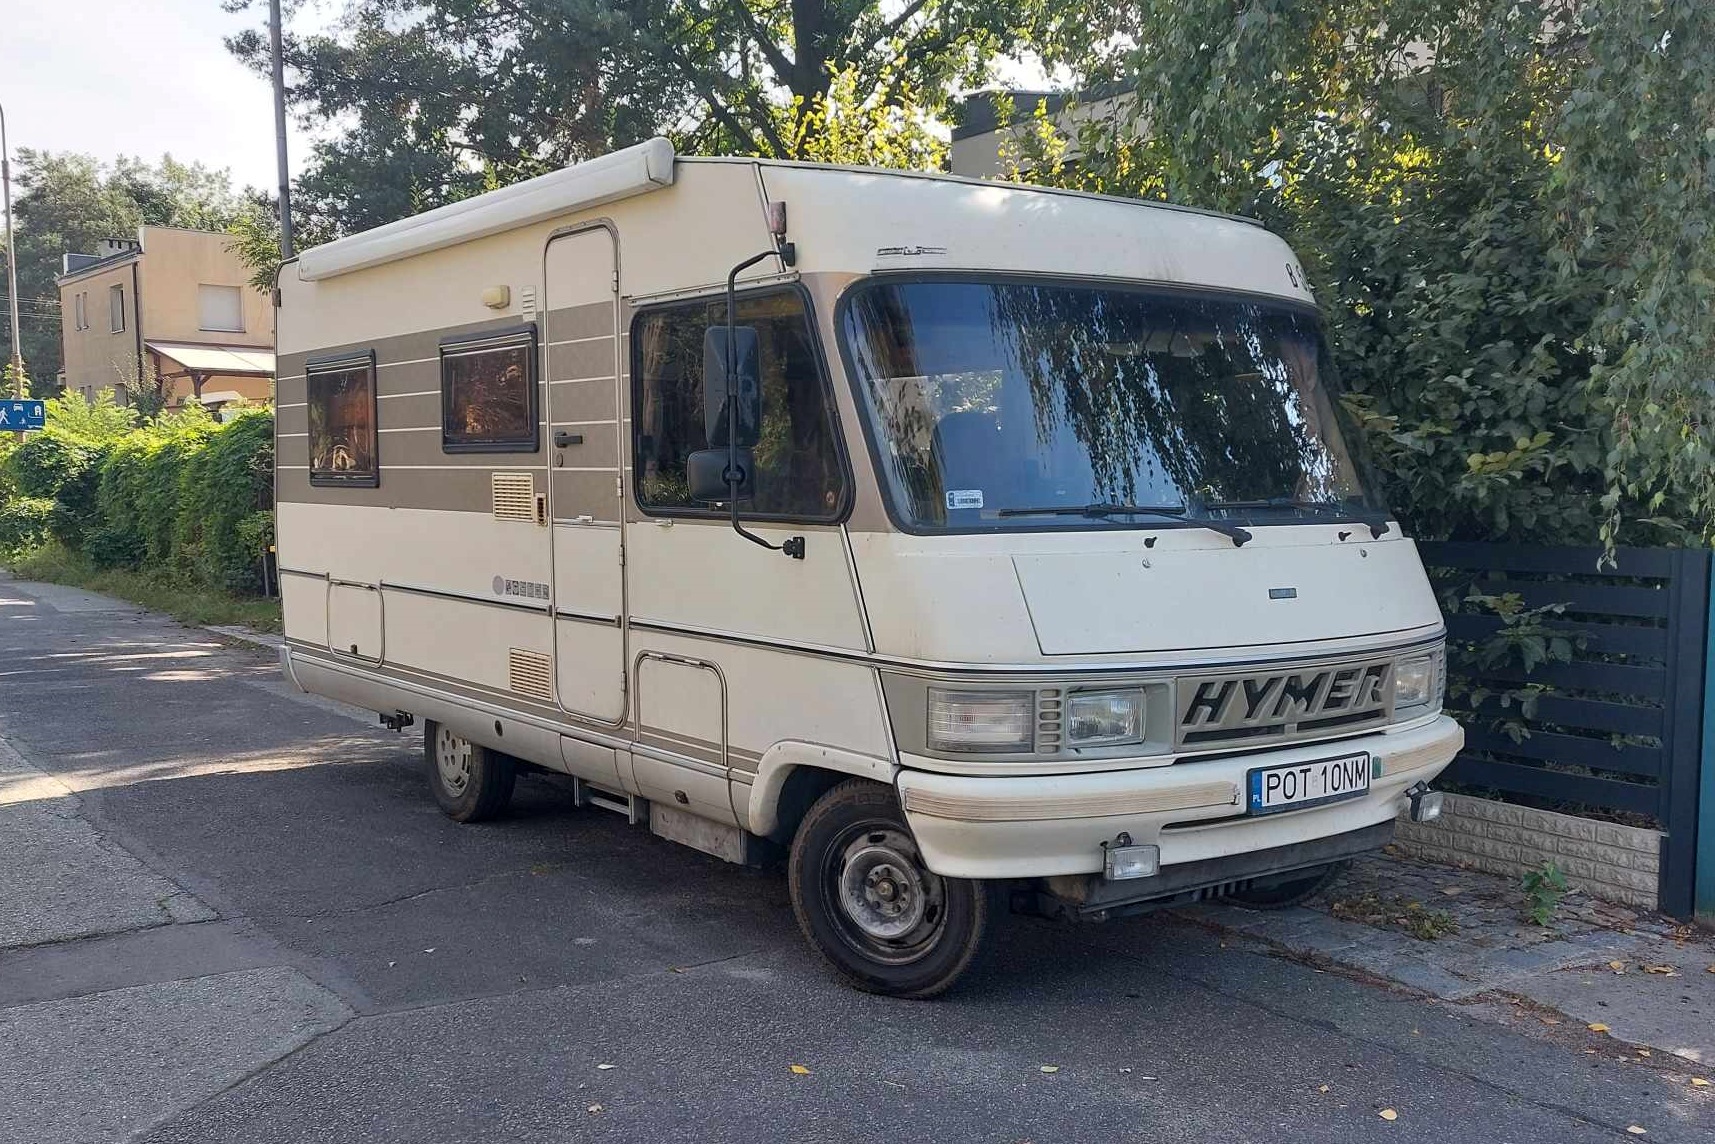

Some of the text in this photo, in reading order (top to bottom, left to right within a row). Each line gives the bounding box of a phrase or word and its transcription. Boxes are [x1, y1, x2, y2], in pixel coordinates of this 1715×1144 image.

[1181, 663, 1391, 725] HYMER
[1266, 758, 1366, 804] POT 10NM
